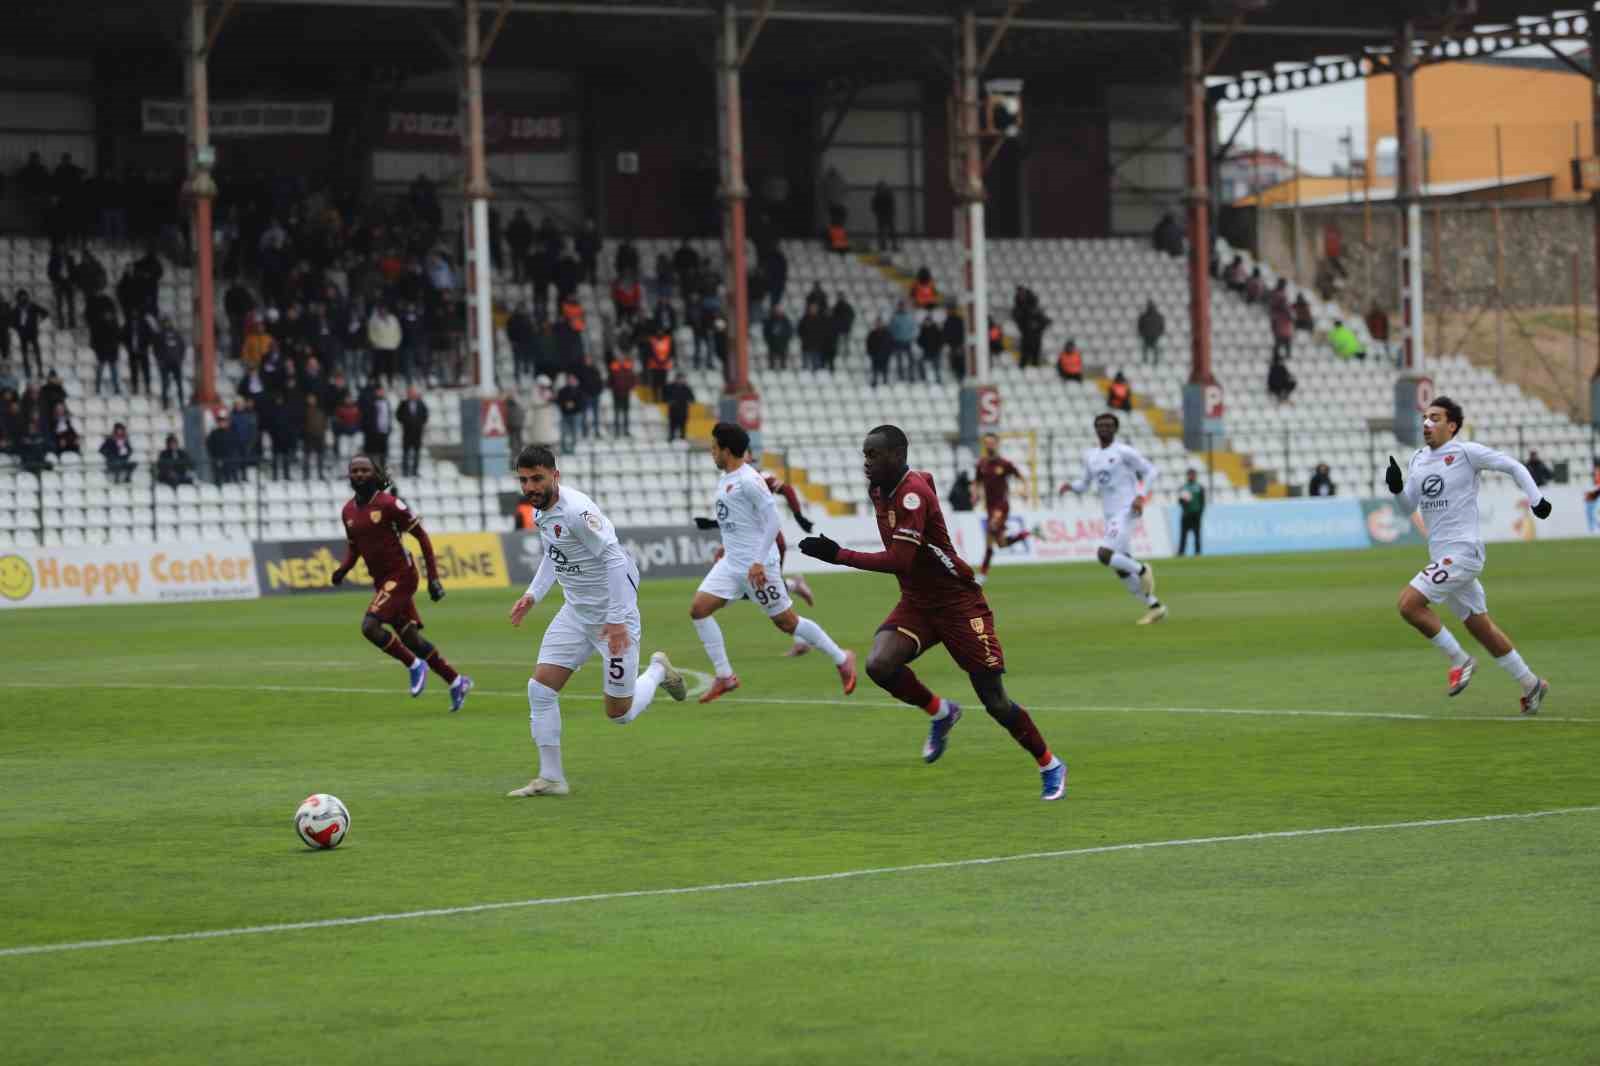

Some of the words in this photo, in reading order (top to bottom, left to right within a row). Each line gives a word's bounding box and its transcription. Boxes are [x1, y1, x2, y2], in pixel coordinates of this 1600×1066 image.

[482, 401, 507, 434] A
[980, 391, 1000, 423] S
[36, 558, 140, 596] Happy
[149, 553, 250, 582] Center
[1423, 561, 1449, 584] 20
[755, 585, 781, 605] 98
[608, 657, 625, 680] 5
